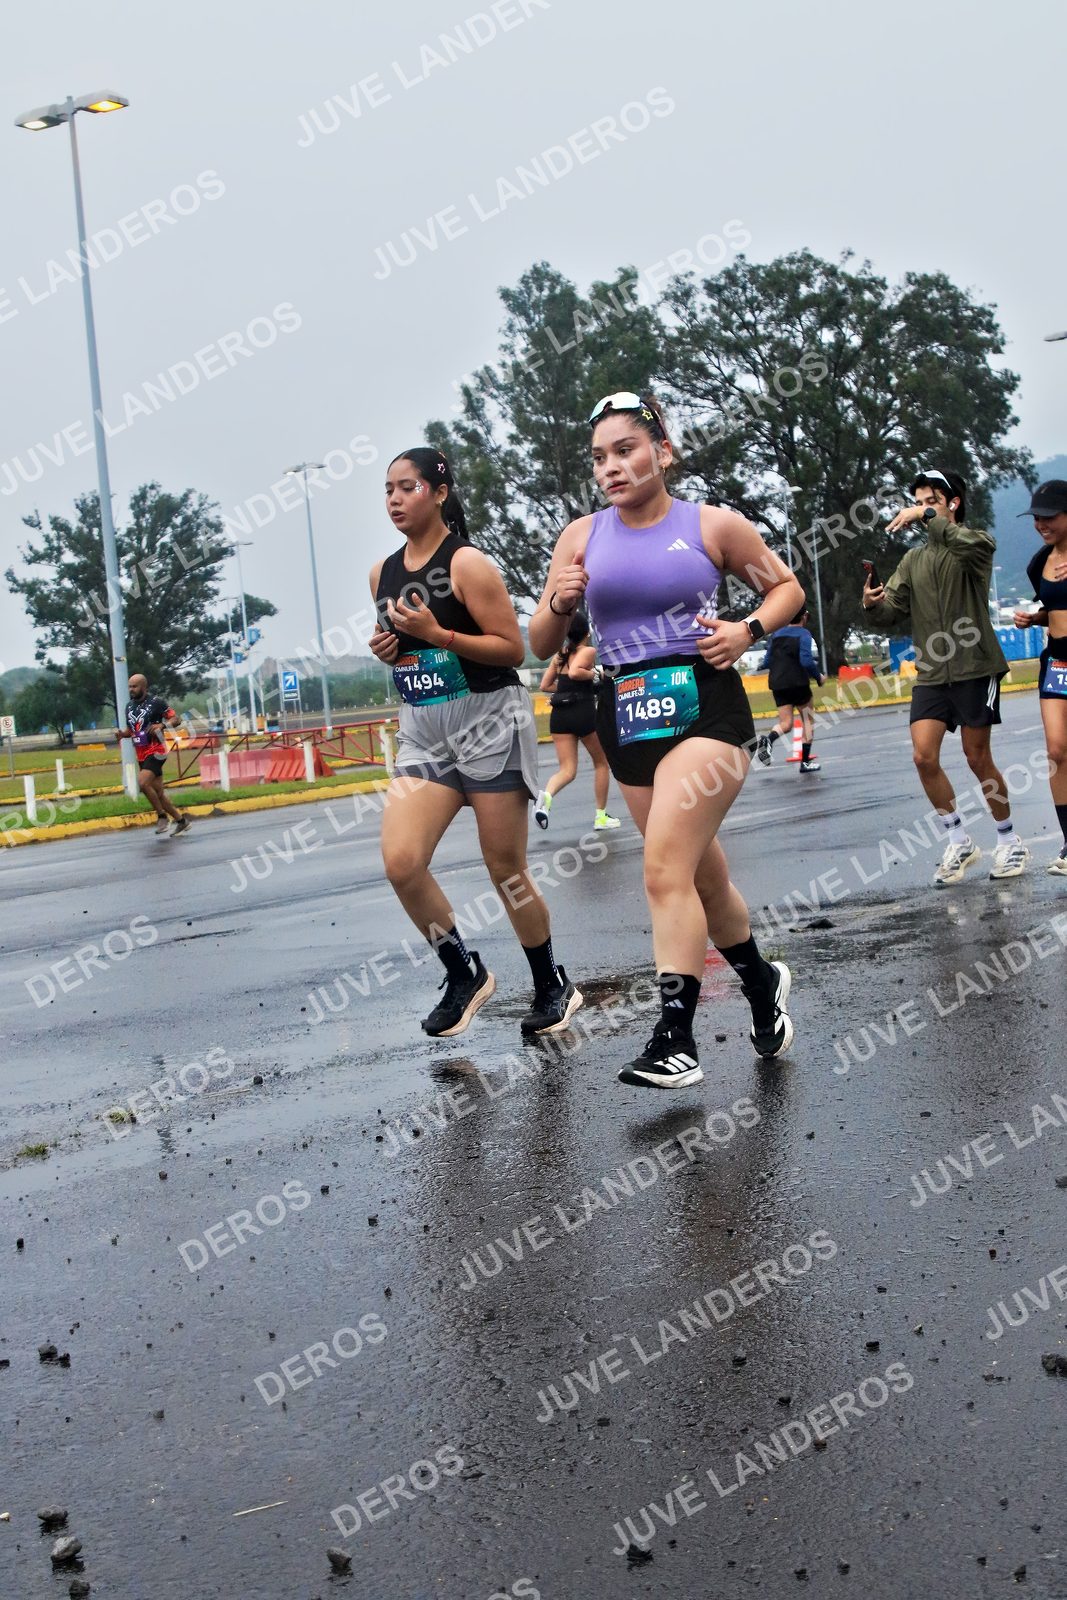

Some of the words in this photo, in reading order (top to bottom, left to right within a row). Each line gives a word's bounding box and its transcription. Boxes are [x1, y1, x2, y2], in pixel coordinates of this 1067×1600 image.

[434, 651, 449, 664] 10K
[404, 672, 444, 691] 1494
[671, 671, 688, 686] 10K
[625, 697, 676, 722] 1489
